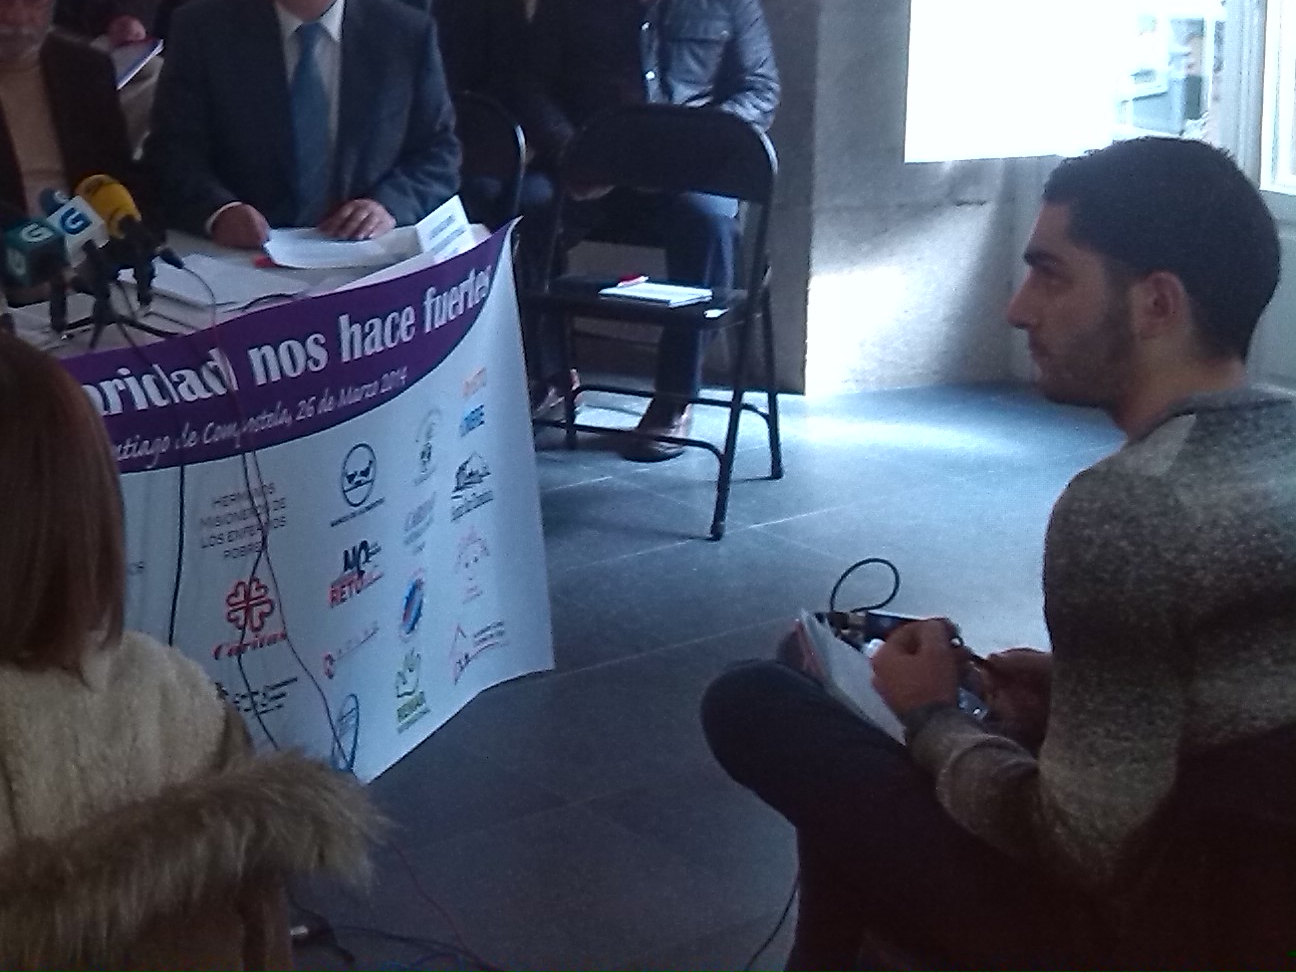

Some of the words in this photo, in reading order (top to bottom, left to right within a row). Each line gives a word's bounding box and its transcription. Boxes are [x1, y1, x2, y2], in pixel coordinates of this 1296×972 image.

[247, 331, 330, 388] nos
[337, 304, 416, 364] hace
[295, 395, 317, 421] 26
